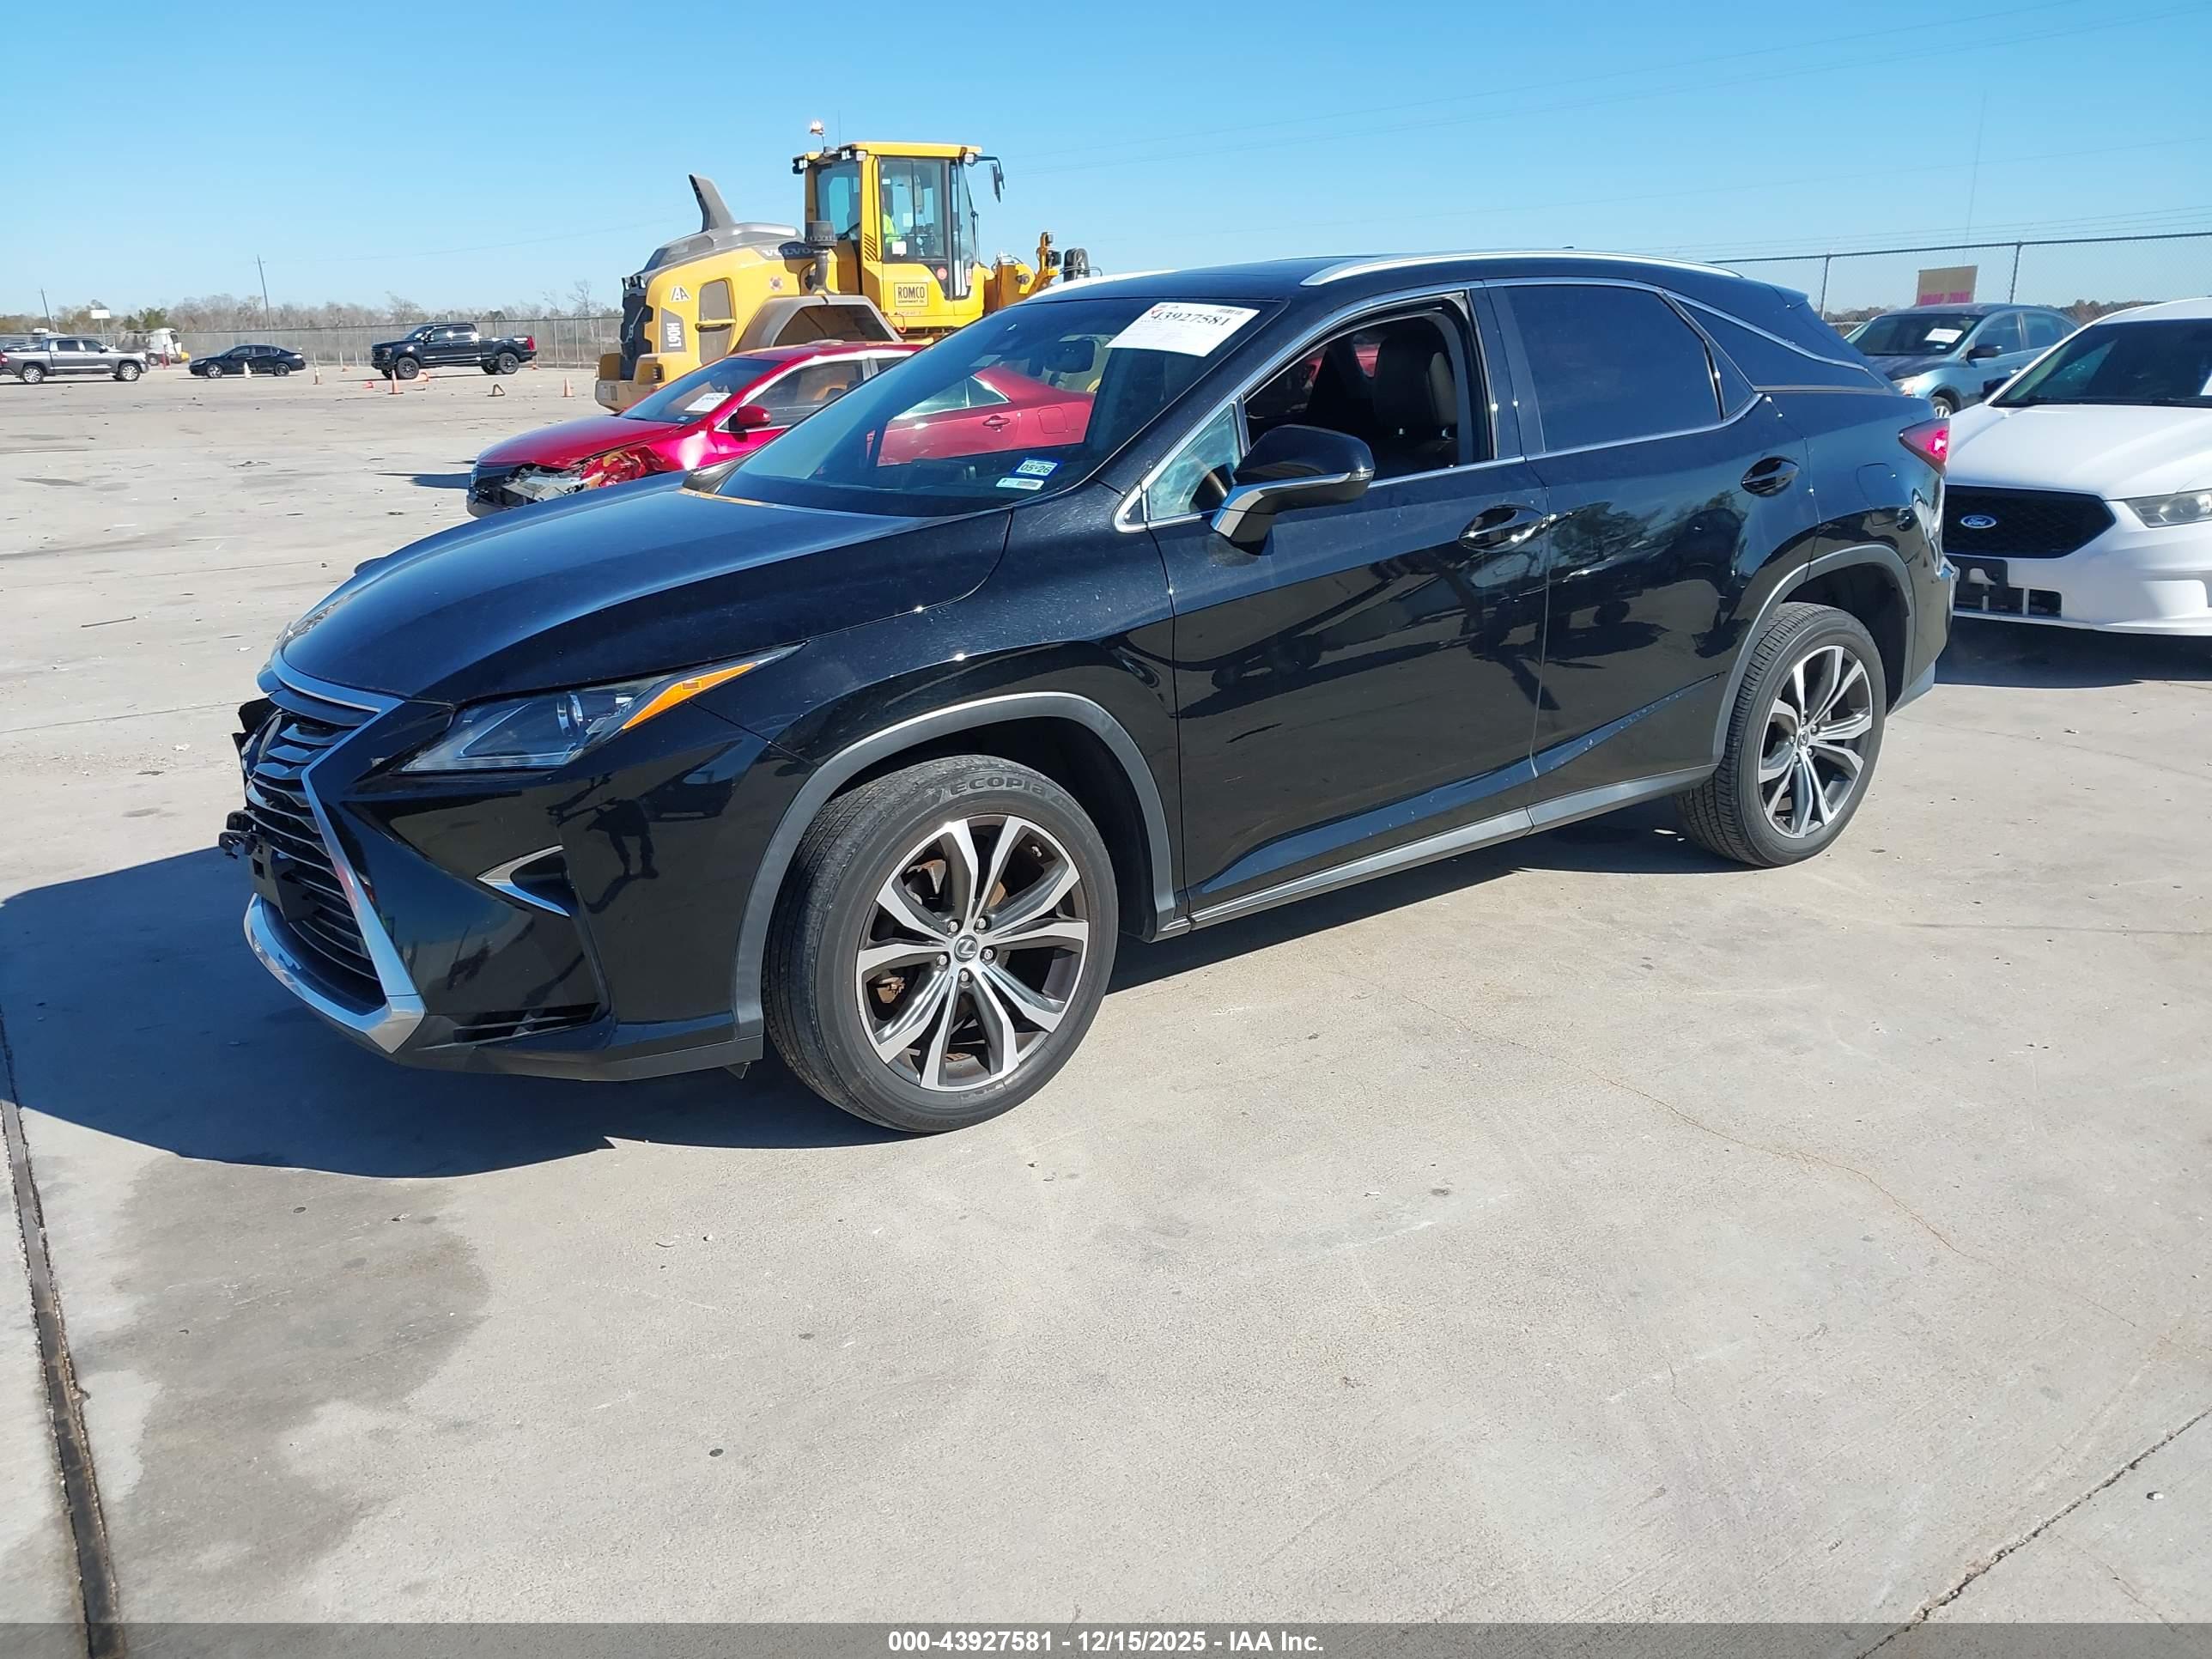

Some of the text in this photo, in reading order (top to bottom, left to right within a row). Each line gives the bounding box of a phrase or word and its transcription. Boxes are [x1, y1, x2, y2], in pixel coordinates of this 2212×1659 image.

[763, 246, 811, 256] VOLVO
[897, 286, 926, 299] ROMCO
[1151, 311, 1231, 325] 43927581
[665, 322, 683, 348] L90H
